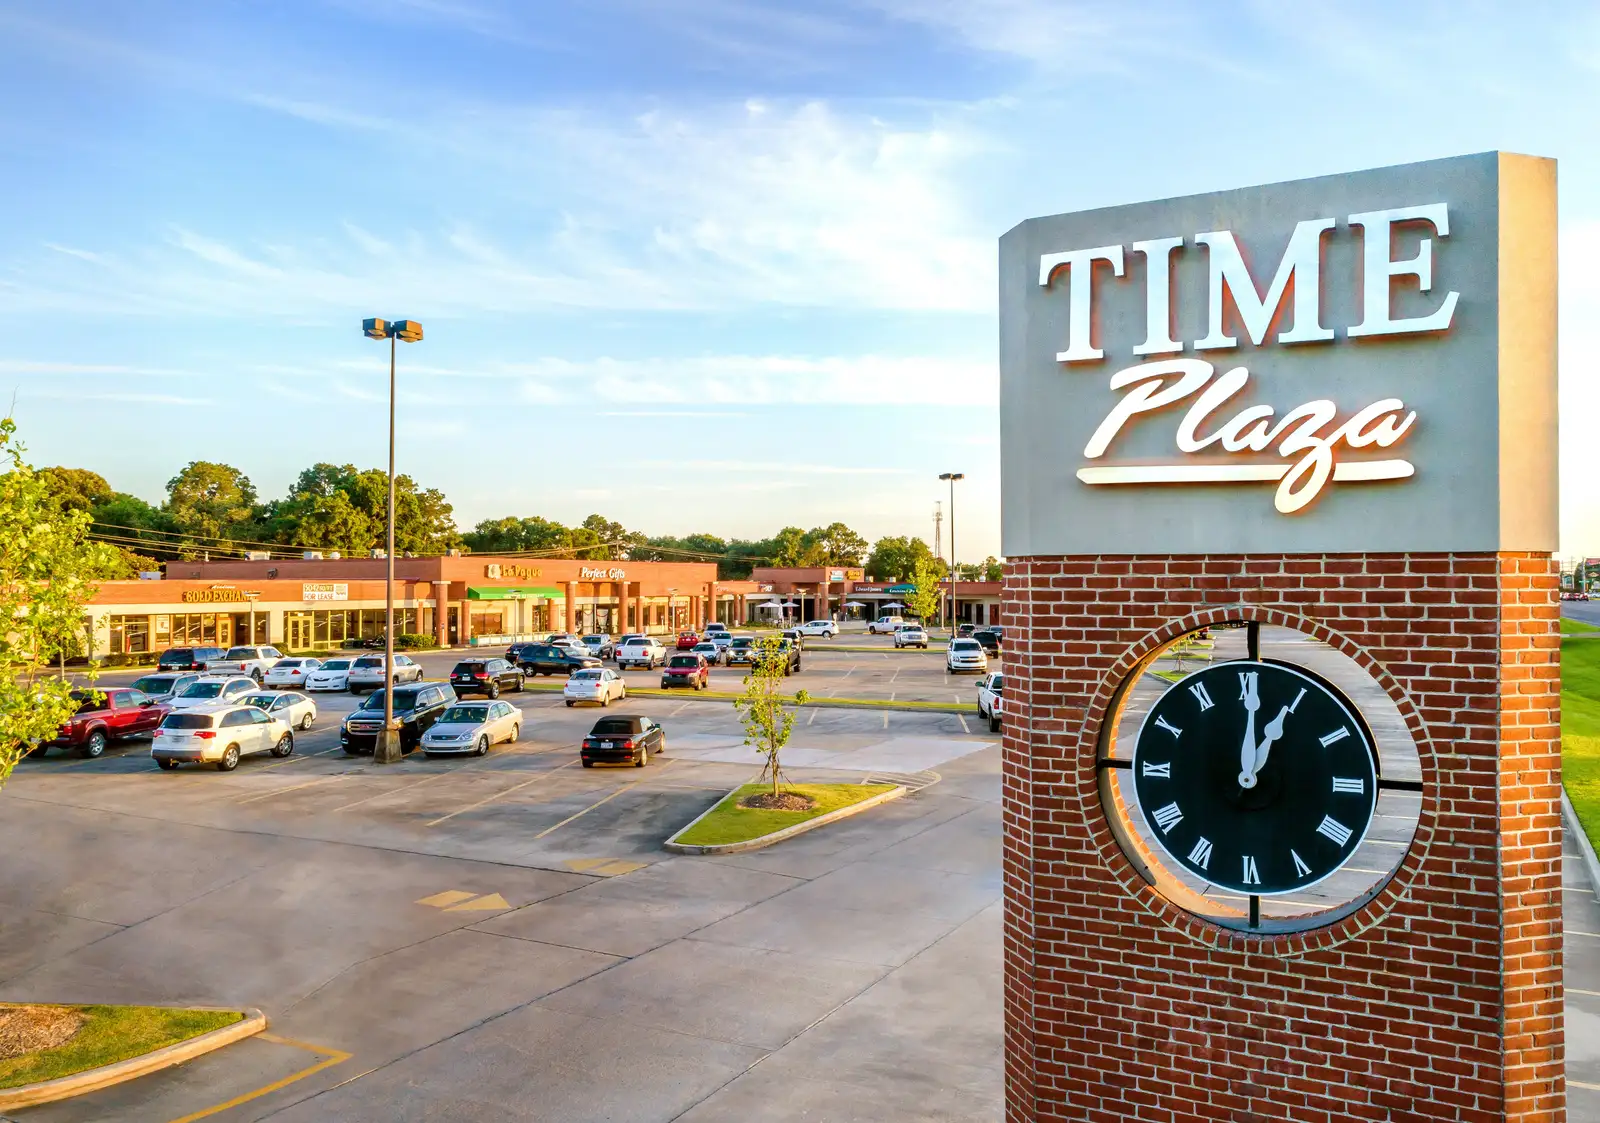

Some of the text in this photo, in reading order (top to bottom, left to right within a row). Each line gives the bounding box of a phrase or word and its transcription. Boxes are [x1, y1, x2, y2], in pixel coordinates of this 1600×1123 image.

[1038, 202, 1460, 363] TIME
[1083, 357, 1417, 514] Plaza
[186, 590, 258, 603] GOLD EXCHAN
[581, 566, 625, 580] Perfect Gifts
